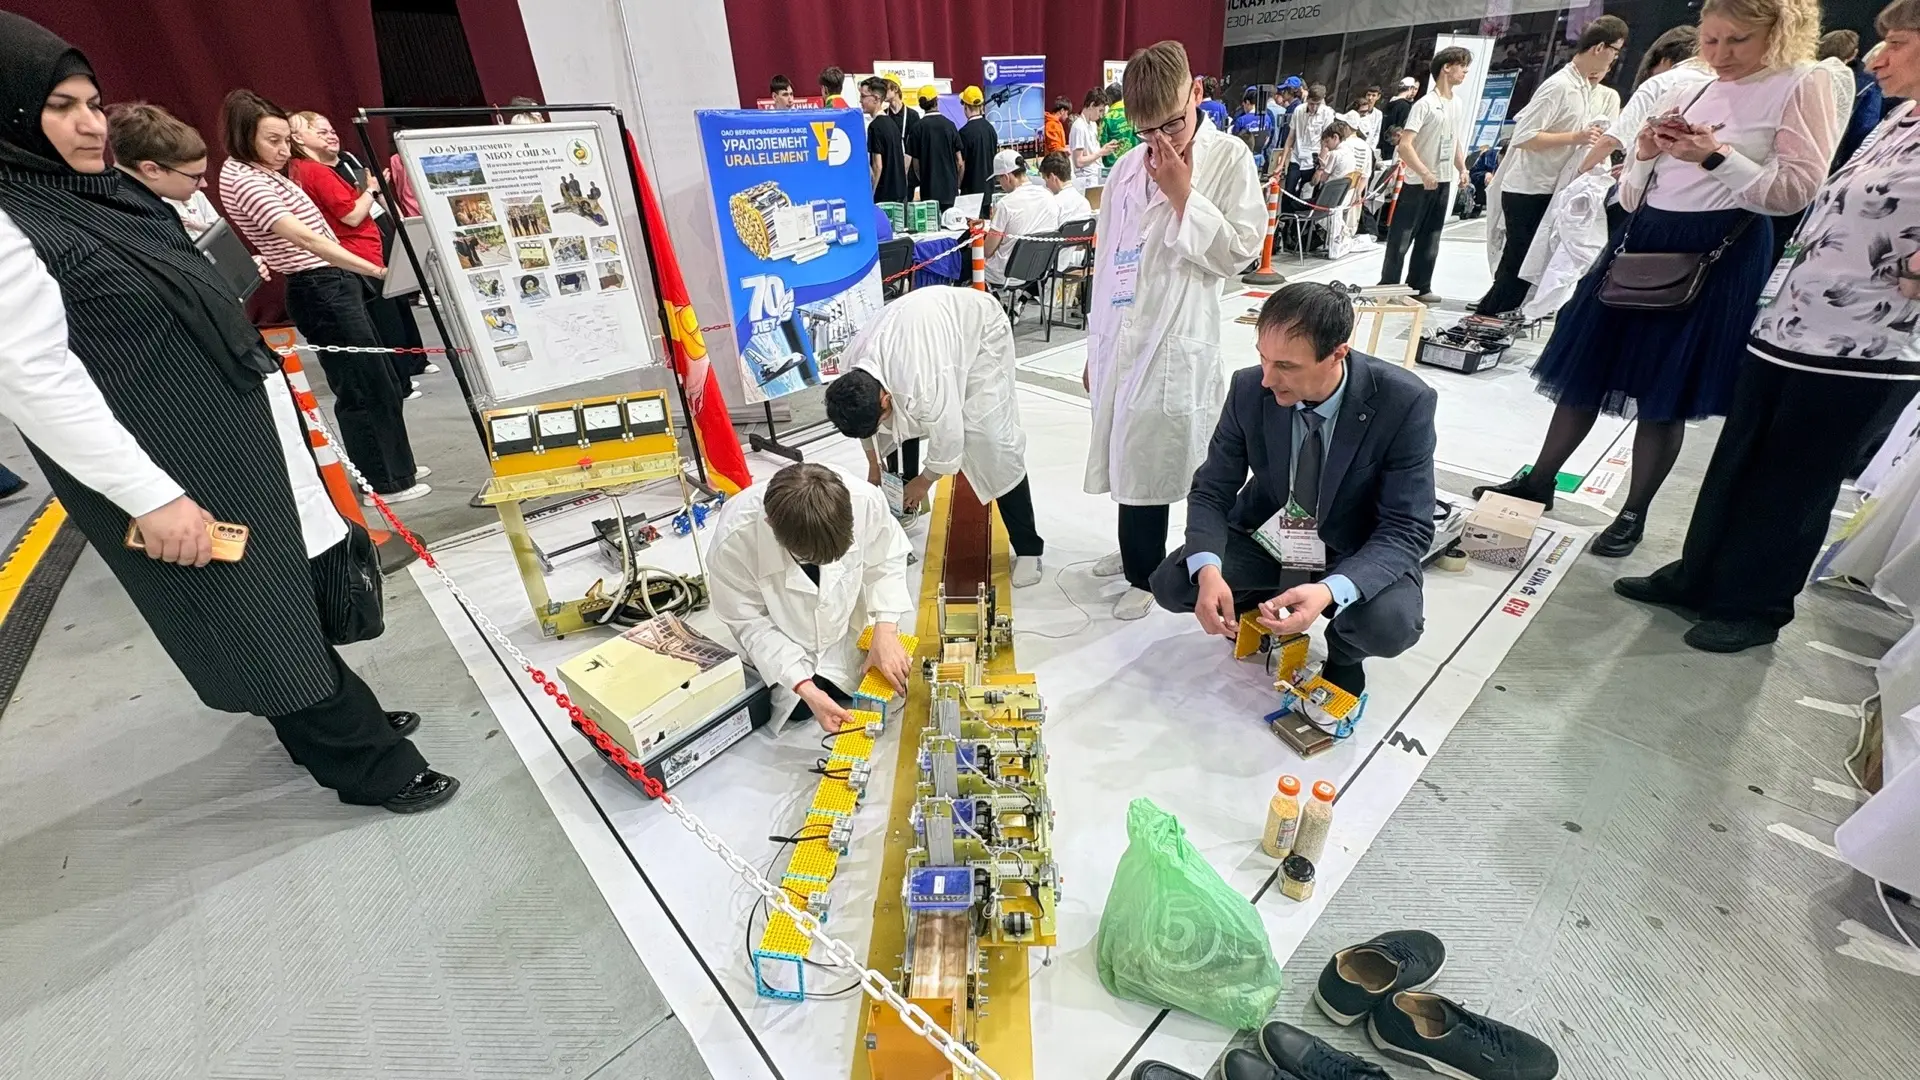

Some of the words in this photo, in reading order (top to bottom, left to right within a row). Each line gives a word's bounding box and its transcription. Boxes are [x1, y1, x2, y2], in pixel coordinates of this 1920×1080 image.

[720, 129, 734, 137] ОАО
[790, 127, 808, 135] ЗАВОД
[428, 146, 443, 155] АО
[722, 136, 809, 152] УРАЛЭЛЕМЕНТ
[484, 150, 514, 161] МБОУ
[515, 148, 540, 159] СОШ
[725, 150, 810, 167] URALELEMENT
[740, 273, 786, 323] 70
[752, 318, 778, 335] ЛЕТ
[1526, 567, 1553, 586] ЧКПЗ
